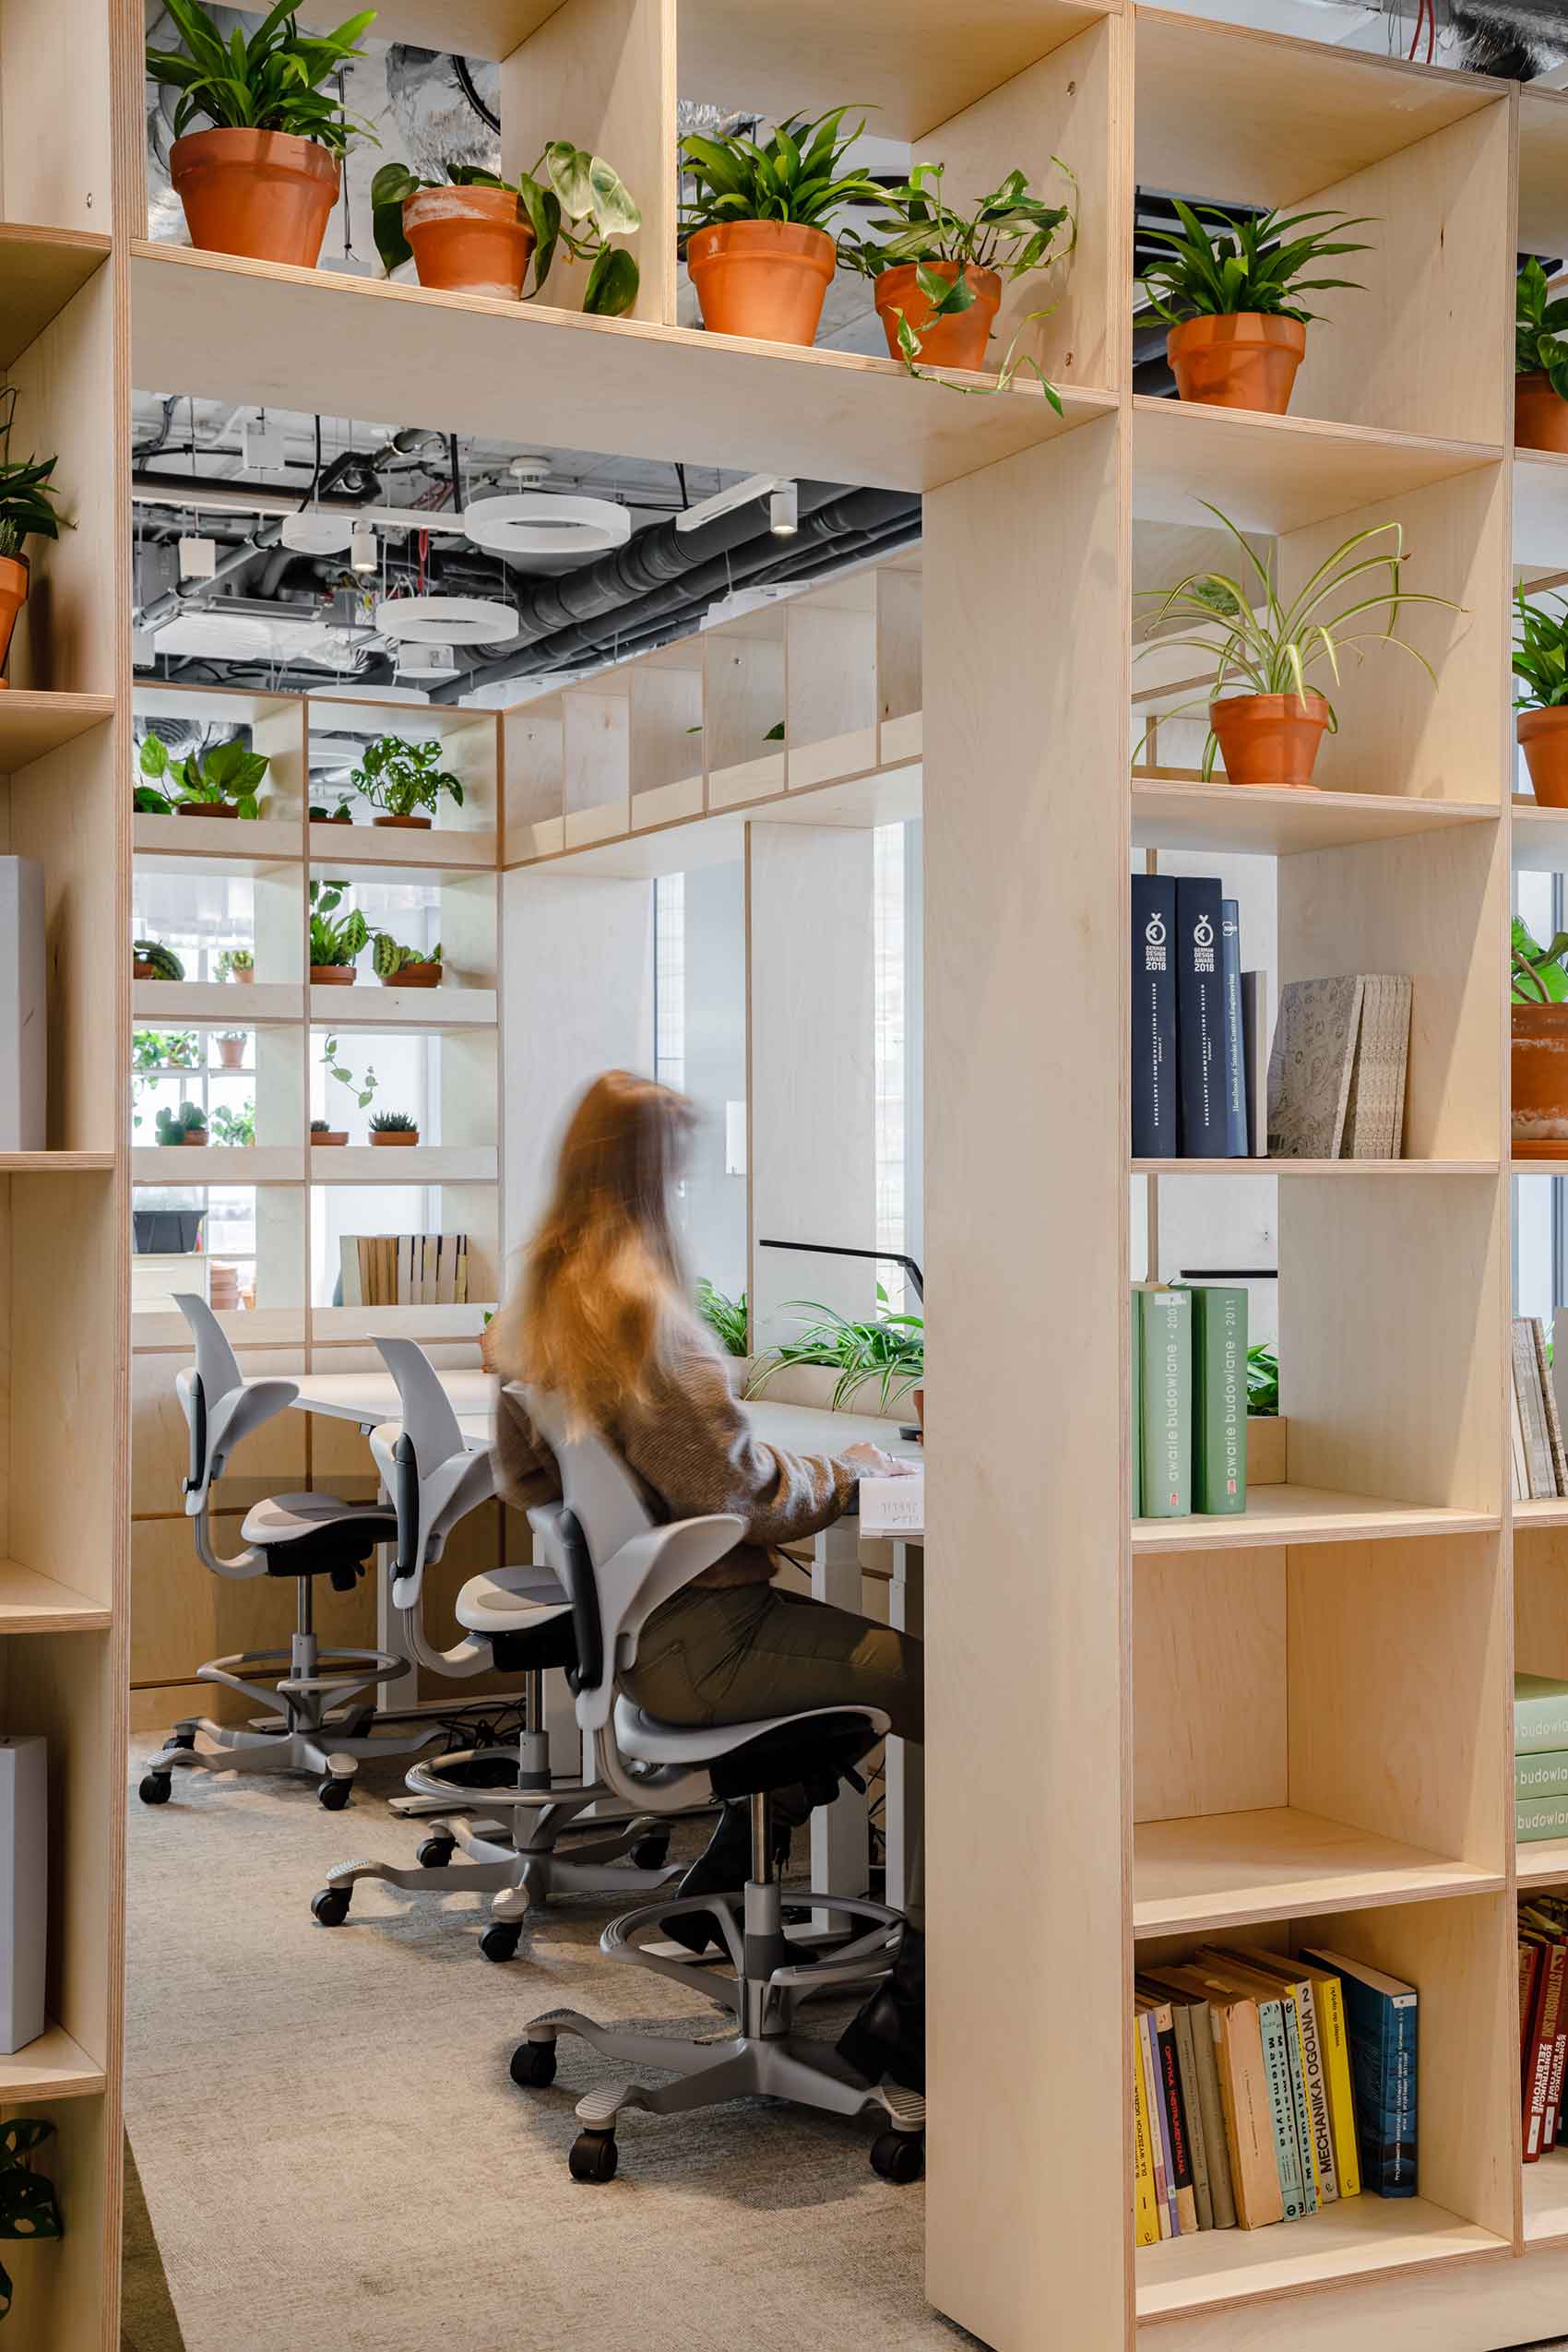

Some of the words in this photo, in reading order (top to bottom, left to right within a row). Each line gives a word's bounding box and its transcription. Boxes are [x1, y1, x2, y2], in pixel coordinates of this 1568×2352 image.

[1146, 962, 1167, 971] 2018
[1194, 964, 1215, 972] 2018
[1228, 973, 1237, 1015] Engineering
[1231, 1076, 1240, 1112] Handbook
[1225, 1300, 1236, 1326] 2011
[1165, 1344, 1178, 1427] budowlane
[1223, 1341, 1236, 1423] budowlane
[1166, 1431, 1179, 1482] awarie
[1224, 1427, 1237, 1477] awarie
[1301, 1987, 1310, 2003] 2
[1165, 2045, 1174, 2086] OPTYKA
[1301, 2008, 1320, 2076] OGÓLNA
[1551, 2033, 1567, 2103] KONSTRUKCJE
[1268, 2037, 1286, 2147] Matematyka
[1538, 2044, 1553, 2113] KONSTRUKCJE
[1169, 2089, 1186, 2175] INSTRUMENTALNA
[1295, 2070, 1313, 2180] Matematyka
[1310, 2078, 1333, 2174] MECHANIKA
